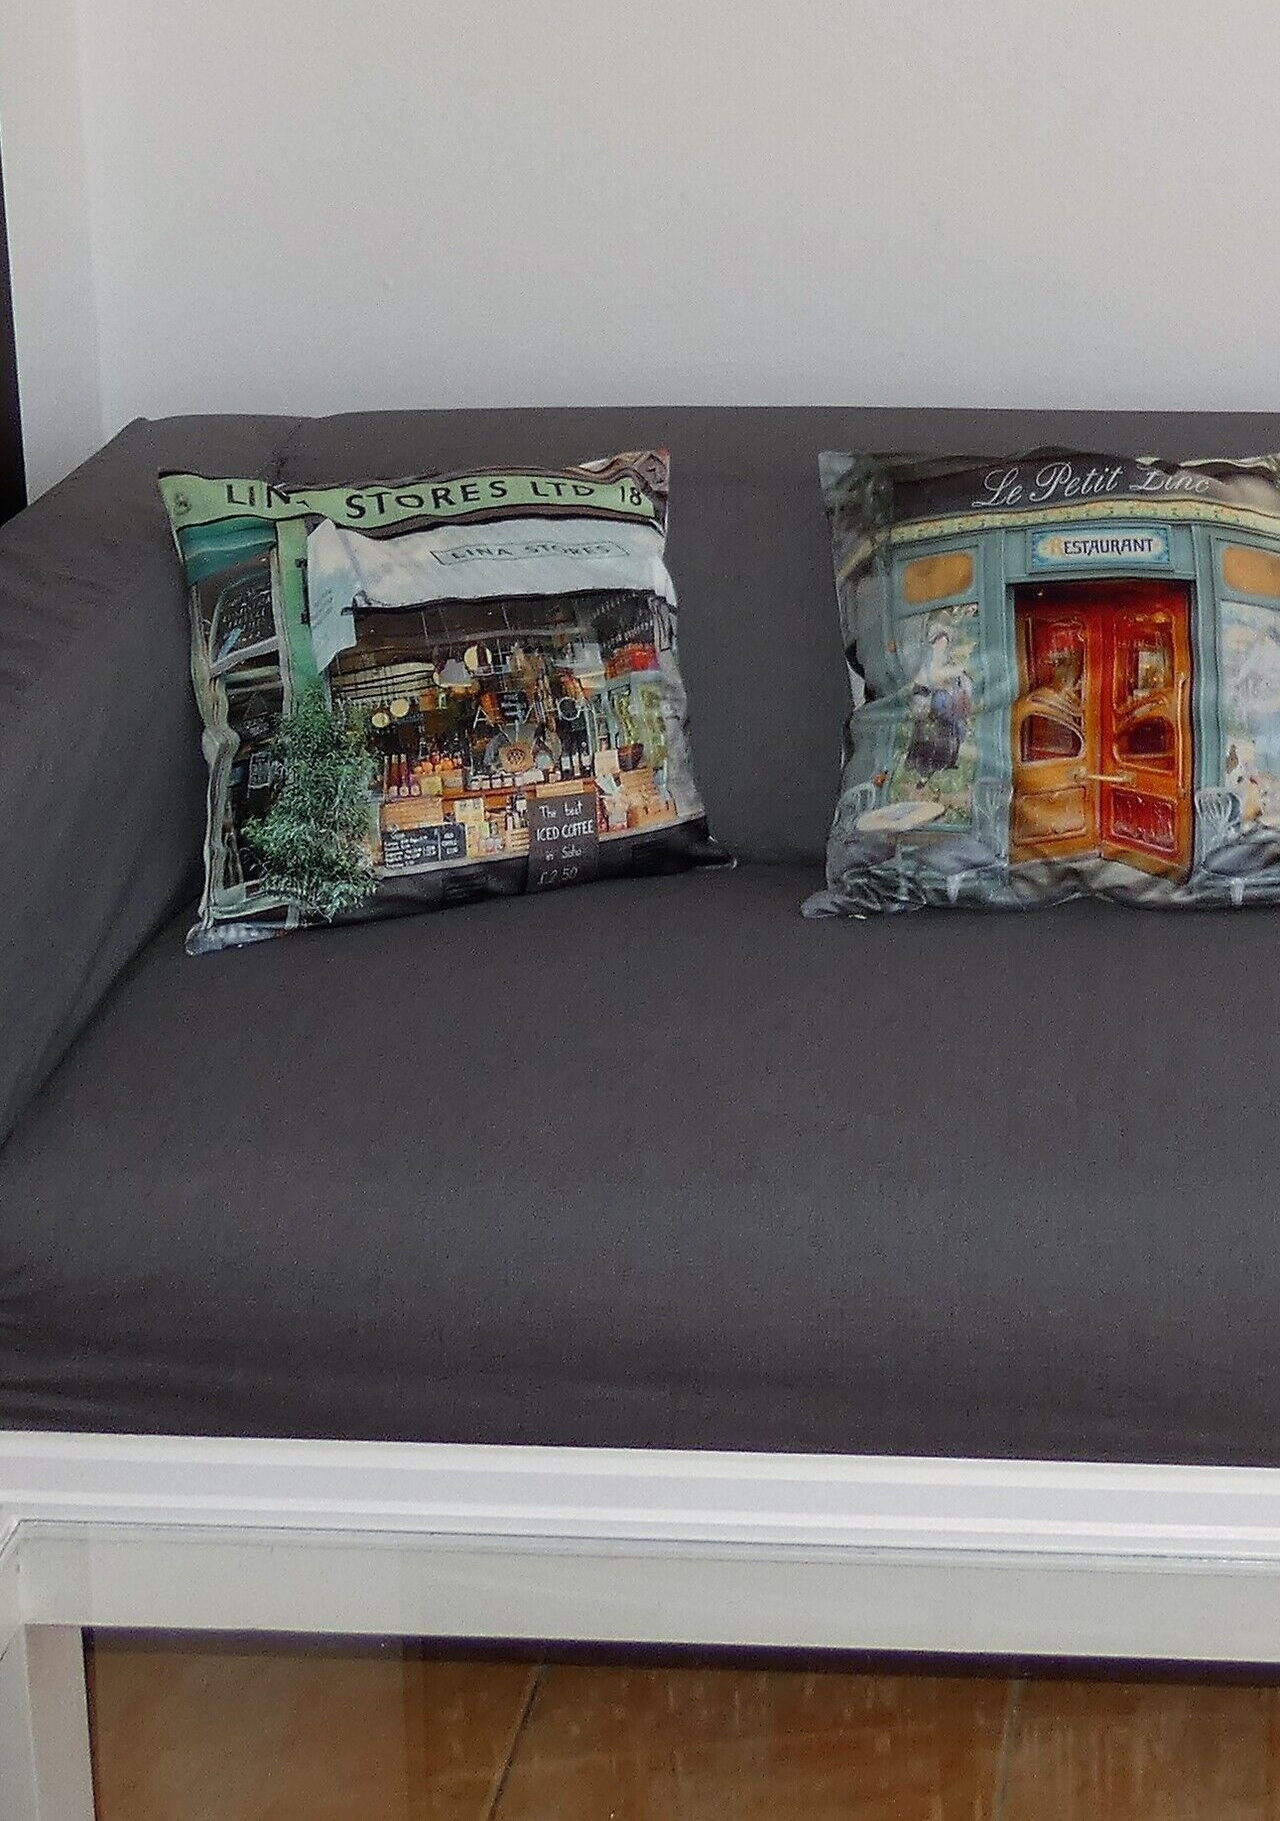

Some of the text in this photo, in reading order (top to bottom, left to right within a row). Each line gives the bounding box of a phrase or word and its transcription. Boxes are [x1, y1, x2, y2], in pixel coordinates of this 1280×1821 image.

[971, 468, 1023, 507] Le
[1029, 462, 1124, 502] Petit
[226, 483, 312, 509] LIN
[345, 480, 508, 519] STORES
[530, 480, 595, 497] LTD
[620, 485, 642, 506] 18
[451, 546, 513, 559] LINA
[1050, 536, 1154, 557] RESTAURANT
[536, 819, 595, 842] ICED COFFEE
